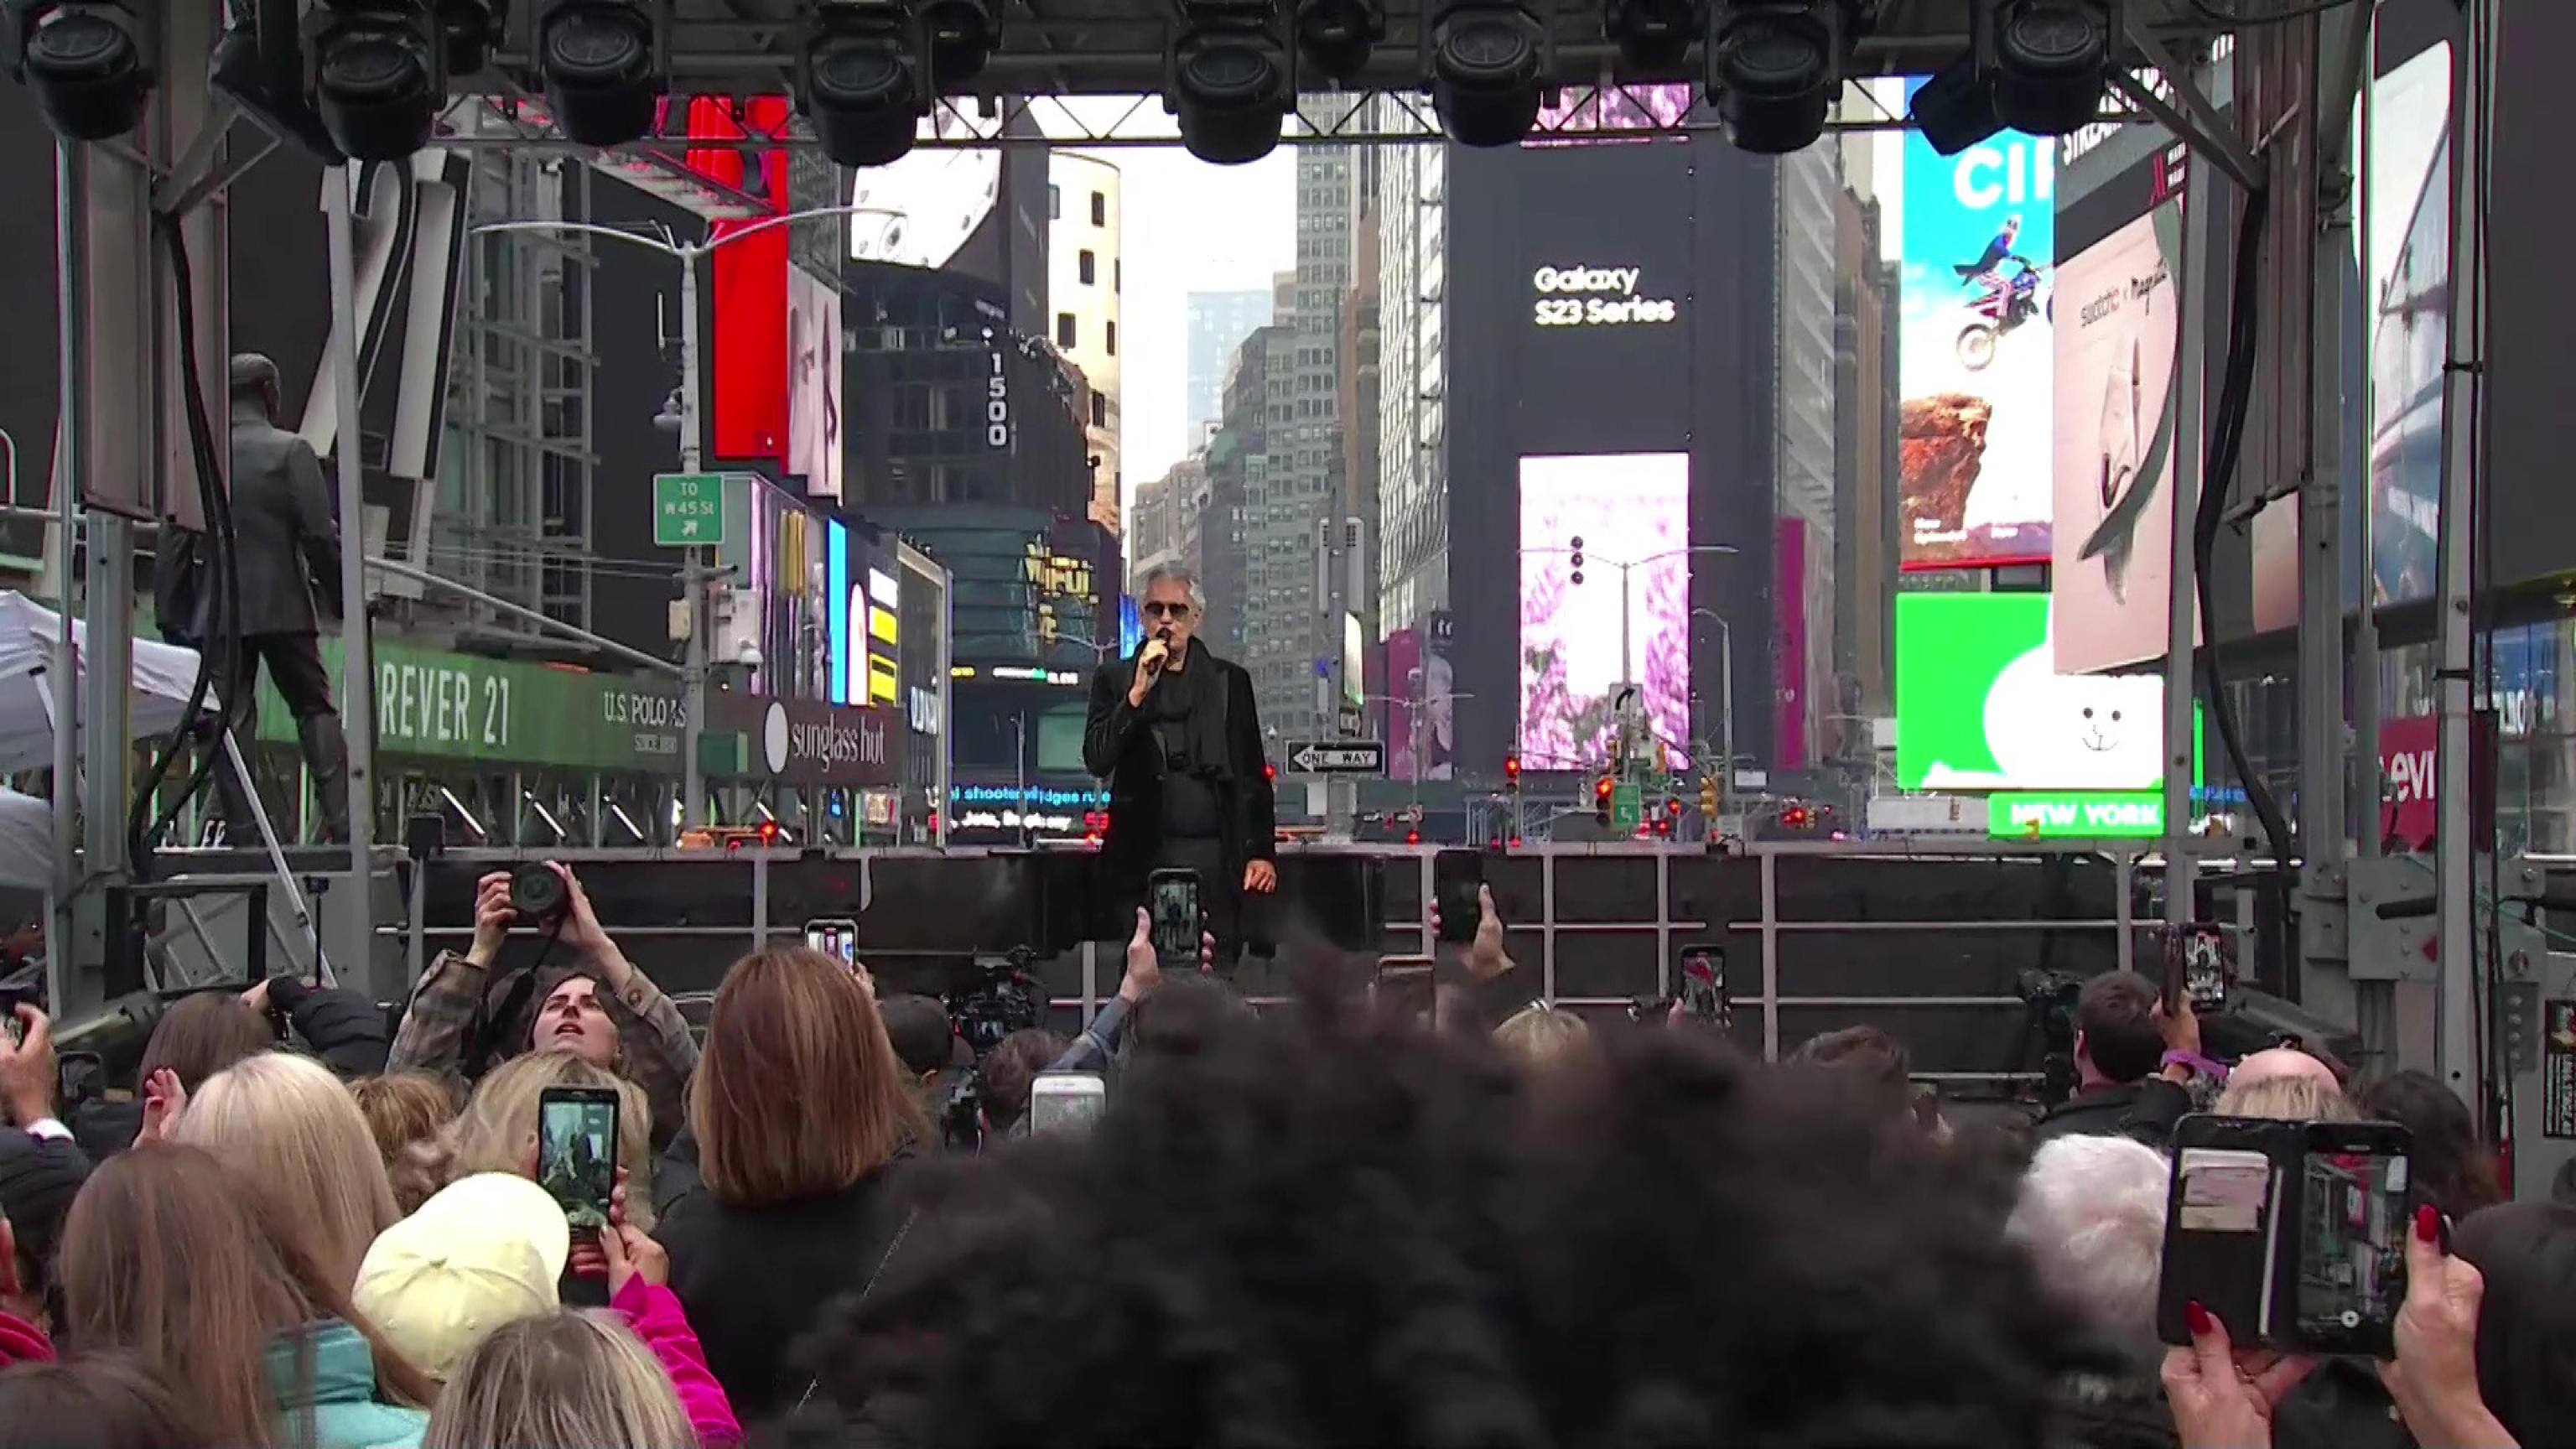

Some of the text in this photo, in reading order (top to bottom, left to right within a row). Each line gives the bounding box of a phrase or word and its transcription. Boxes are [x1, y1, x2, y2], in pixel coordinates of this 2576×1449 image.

[1534, 265, 1640, 295] Galaxy
[1535, 294, 1675, 325] S23 Series
[988, 352, 1007, 446] 1500
[680, 483, 698, 496] TO
[678, 501, 698, 515] 45
[483, 675, 509, 745] 21
[631, 693, 667, 726] POLO
[792, 713, 886, 772] sunglass hut
[1302, 752, 1370, 765] ONE WAY
[2011, 804, 2161, 826] NEW YORK
